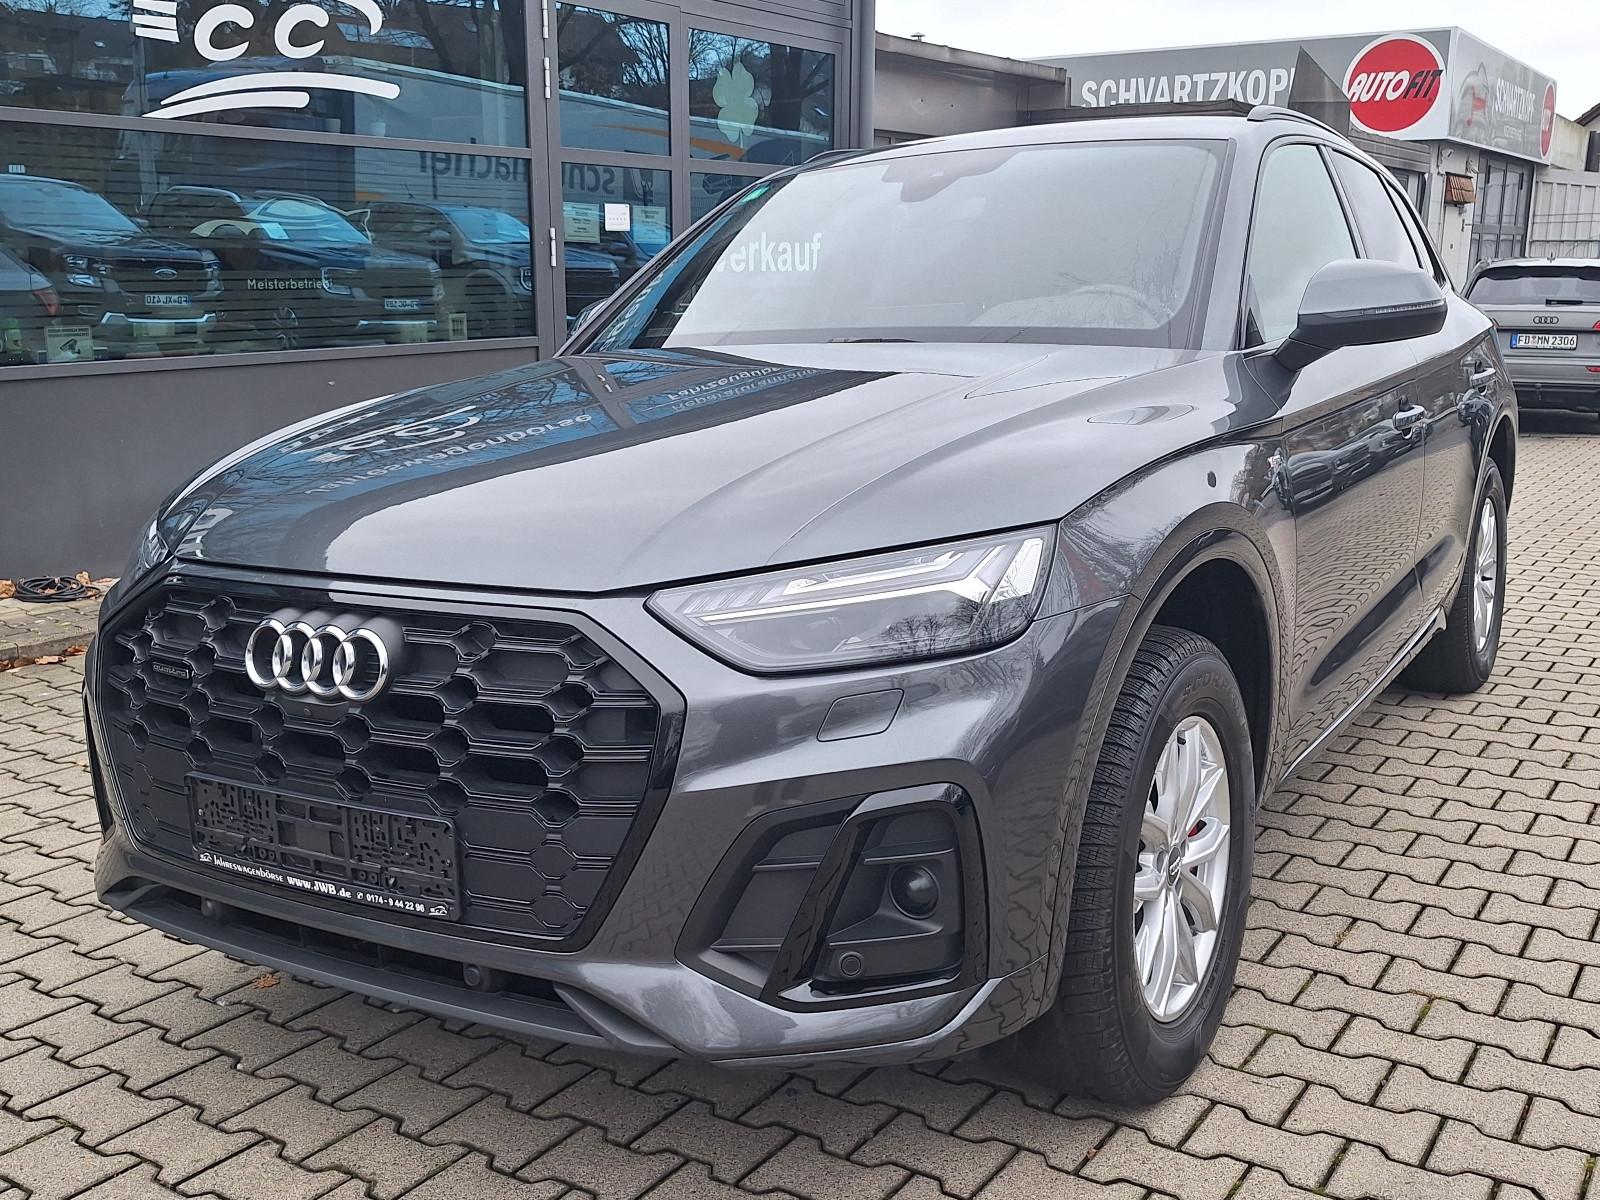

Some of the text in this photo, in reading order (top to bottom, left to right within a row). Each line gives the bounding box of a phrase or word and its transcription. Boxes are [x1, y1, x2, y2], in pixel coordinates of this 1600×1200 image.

[1081, 67, 1296, 107] SCHVARTZKOP
[1348, 70, 1444, 102] AUTOFIT
[1517, 335, 1531, 345] FD
[1551, 336, 1575, 347] 2306
[153, 664, 187, 677] quattro
[286, 875, 352, 899] www.JWB.de
